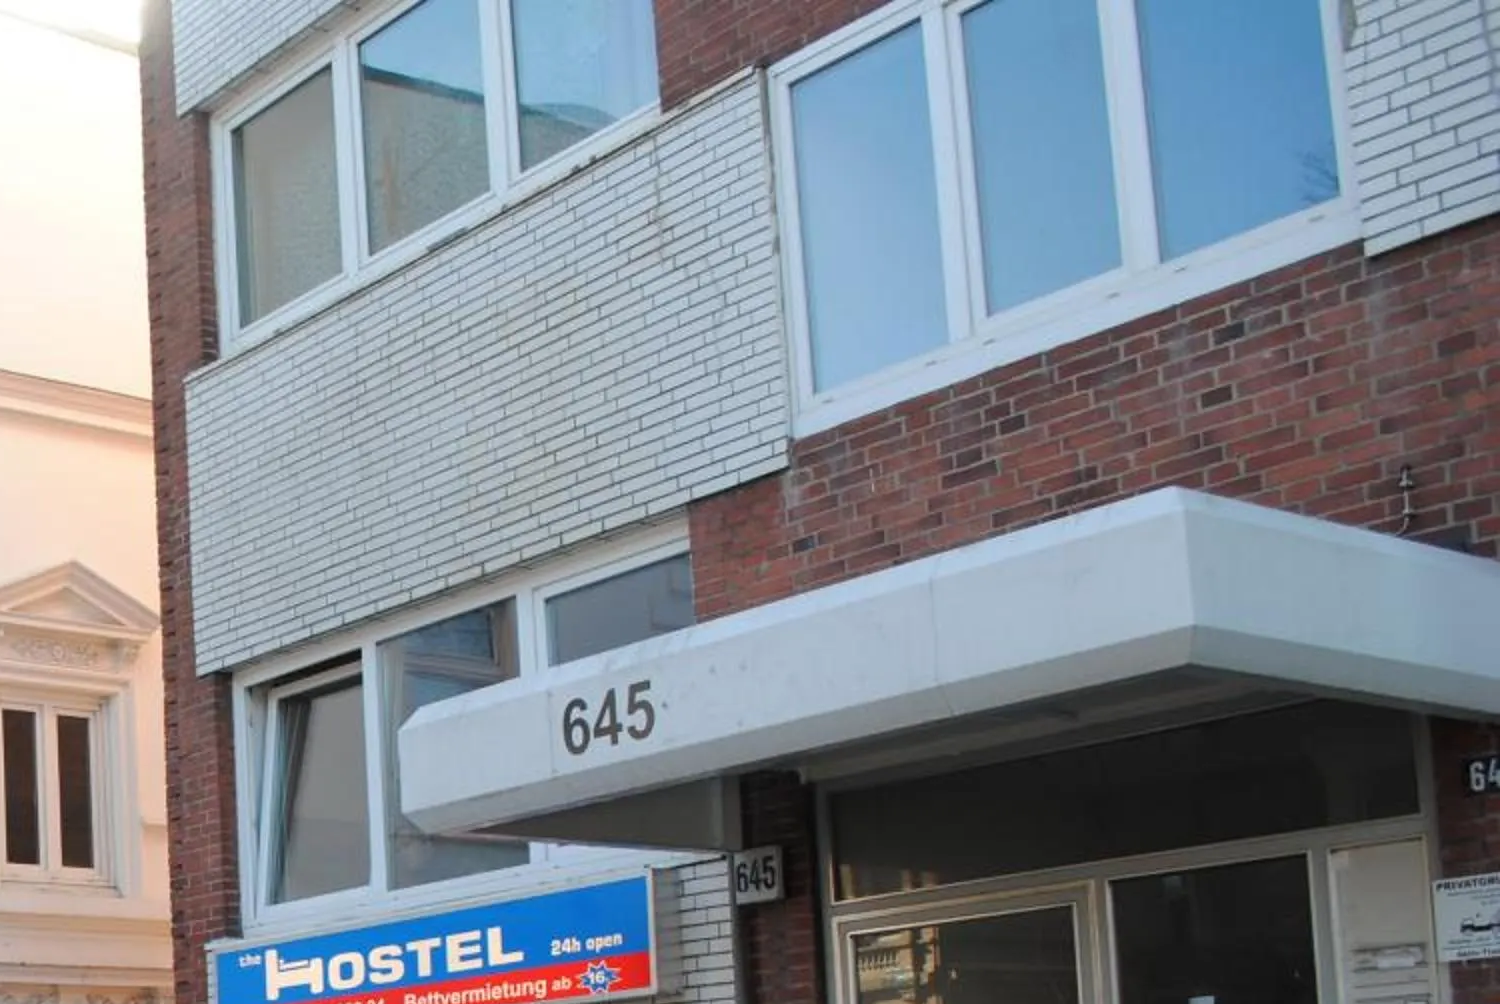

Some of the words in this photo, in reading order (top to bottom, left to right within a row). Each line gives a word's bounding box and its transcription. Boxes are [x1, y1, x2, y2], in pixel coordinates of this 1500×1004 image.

[562, 679, 656, 755] 645
[736, 855, 777, 893] 645
[265, 926, 525, 1001] HOSTEL
[551, 937, 581, 956] 24h
[586, 933, 623, 953] open
[551, 976, 572, 991] ab
